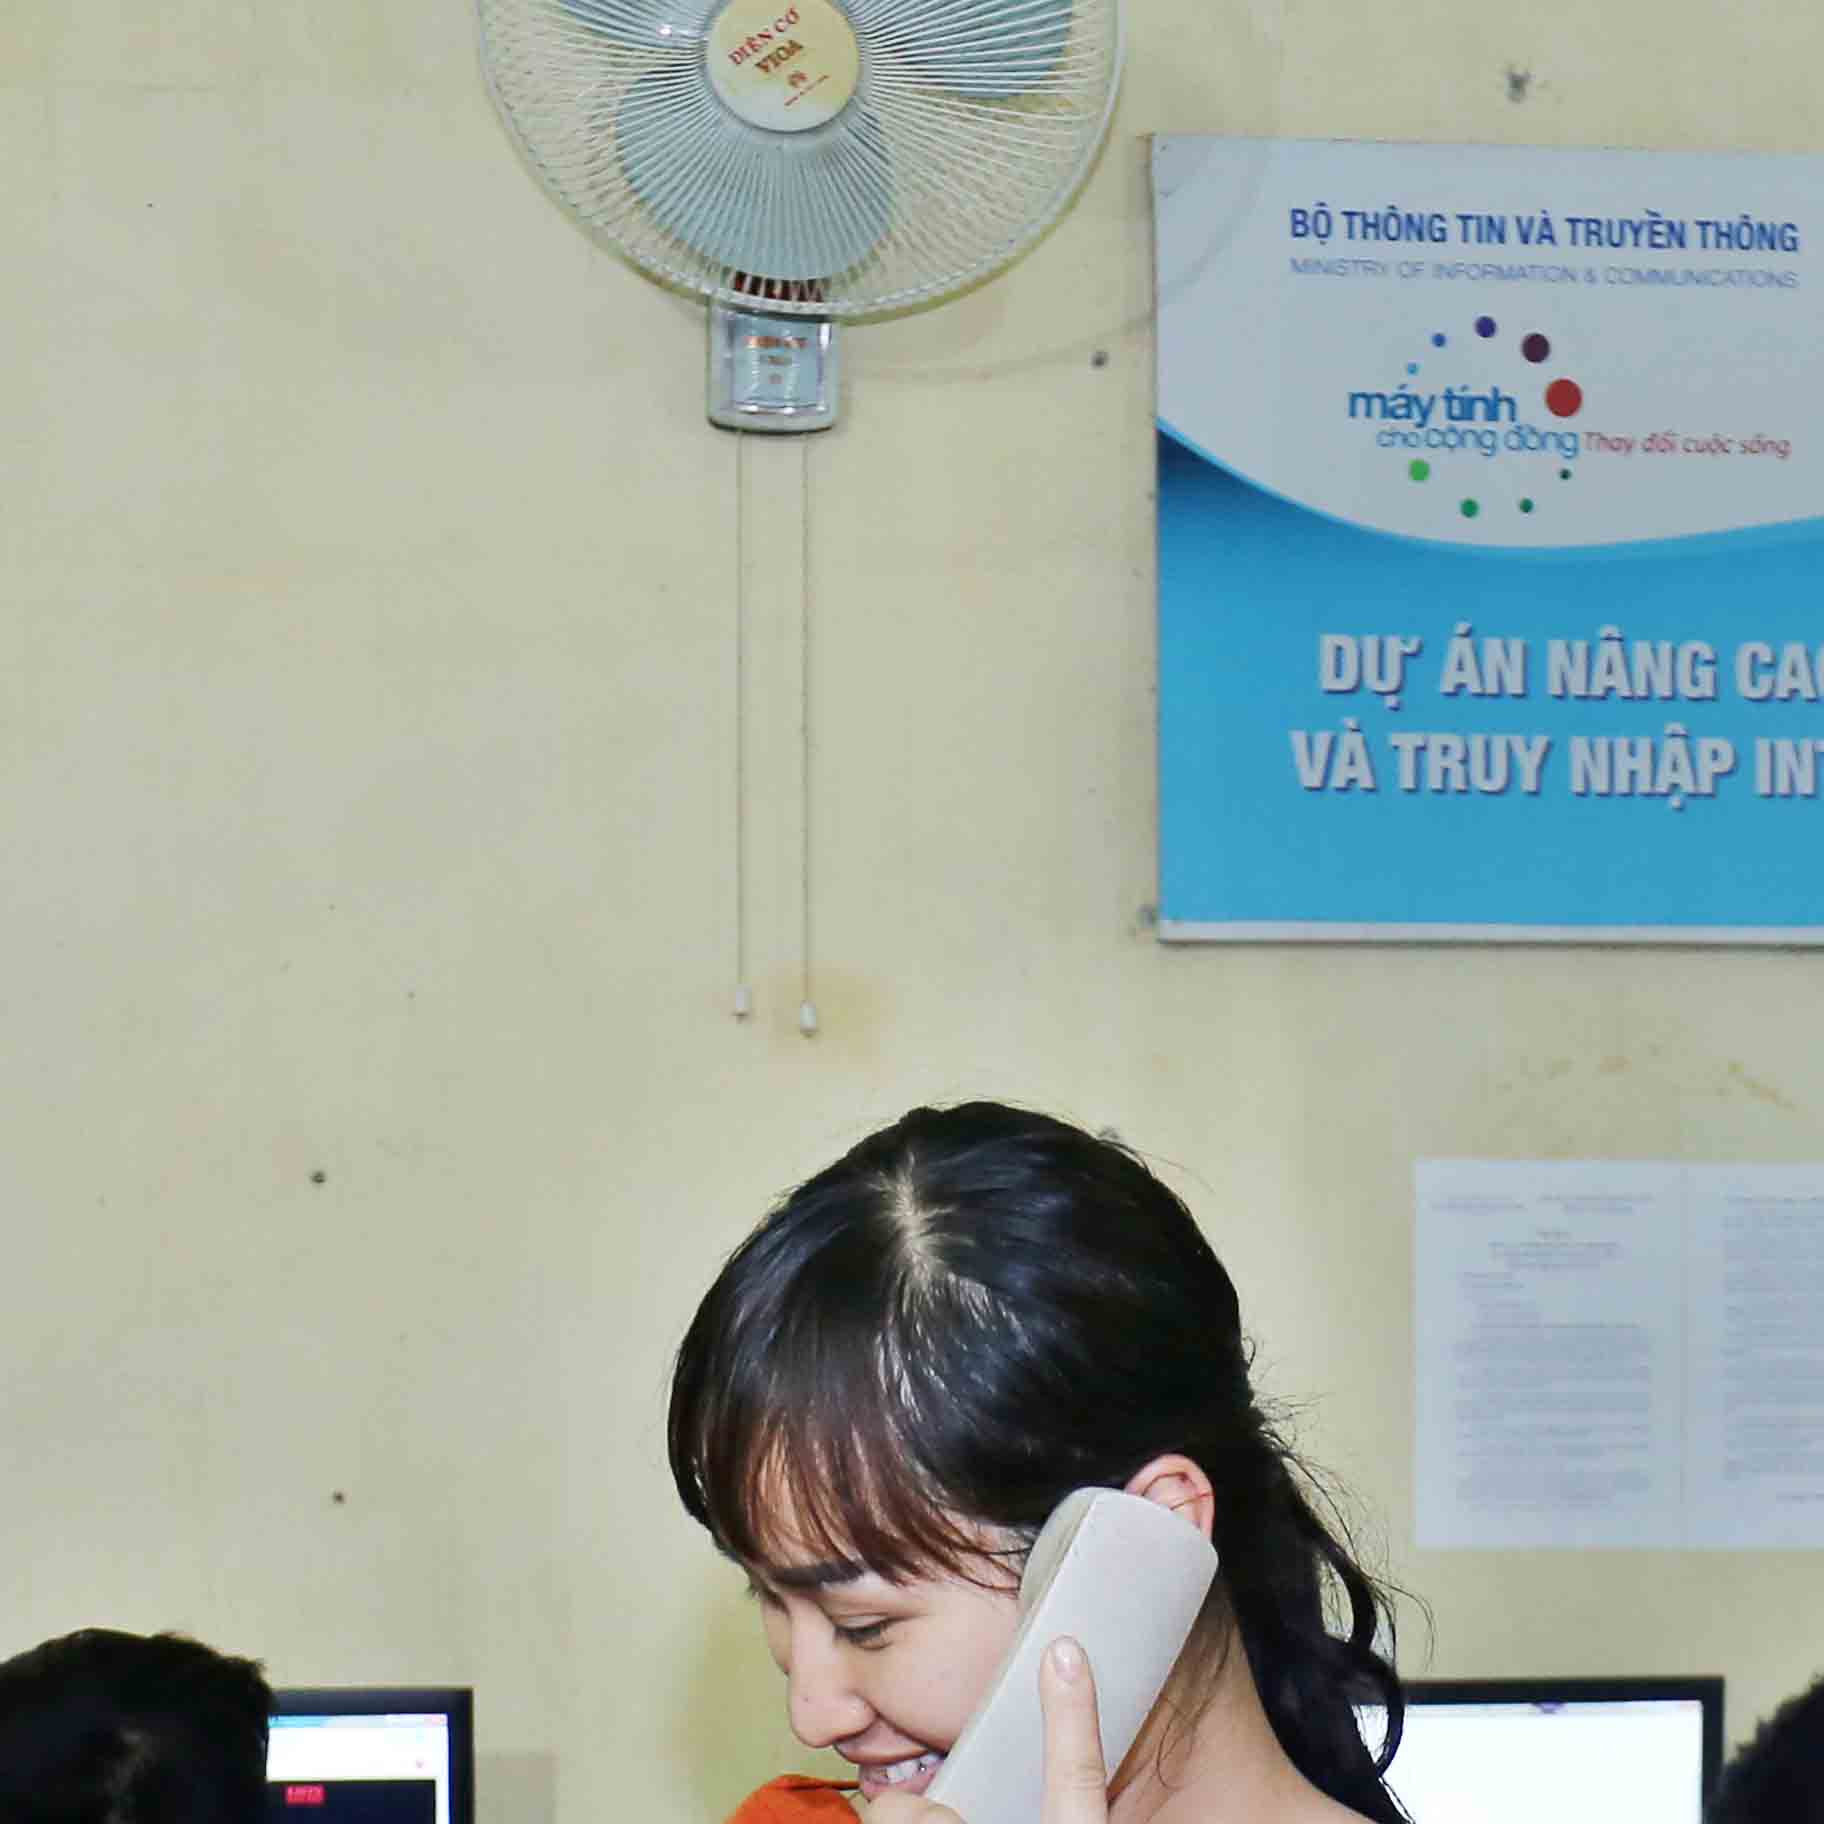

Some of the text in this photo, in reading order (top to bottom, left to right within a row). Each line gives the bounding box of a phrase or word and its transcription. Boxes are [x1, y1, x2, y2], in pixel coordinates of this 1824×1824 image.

[1290, 201, 1799, 253] BỘ THÔNG TIN VÀ TRUYỀN THÔNG
[1289, 257, 1800, 289] MINISTRY OF INFORMATION & COMMUNICATIONS
[1348, 383, 1520, 429] máy tính
[1421, 425, 1498, 461] cộng
[1502, 425, 1581, 461] đồng
[1319, 633, 1420, 707] DỰ
[1439, 622, 1526, 695] ÁN
[1546, 625, 1717, 698] NÂNG
[1290, 718, 1375, 789] VÀ
[1389, 732, 1550, 792] TRUY
[1569, 723, 1735, 808] NHẬP
